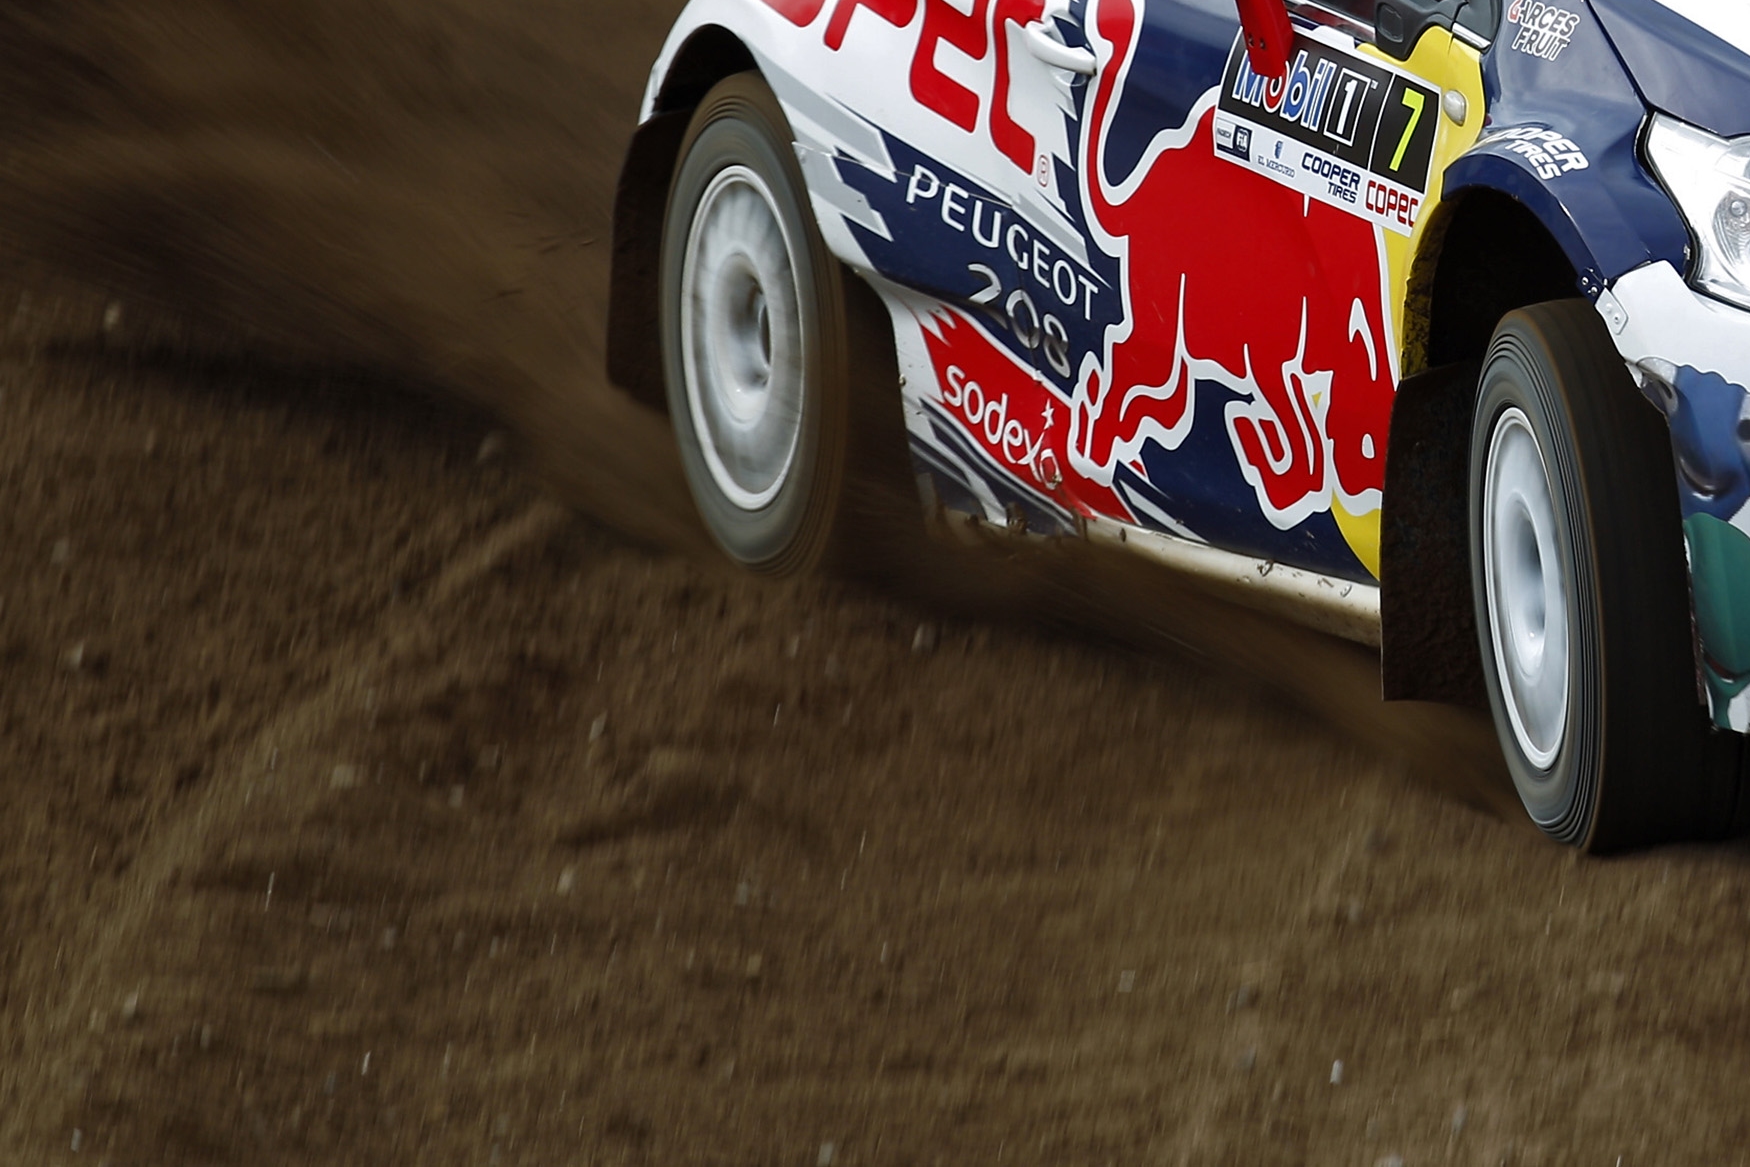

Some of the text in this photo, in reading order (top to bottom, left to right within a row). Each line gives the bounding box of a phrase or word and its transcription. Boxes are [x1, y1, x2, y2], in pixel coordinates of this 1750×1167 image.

[1511, 25, 1571, 64] FRUIT
[1231, 49, 1338, 133] Mobil
[1388, 87, 1426, 172] 7
[1503, 140, 1563, 181] TIRES
[1301, 152, 1361, 191] COOPER
[1327, 181, 1358, 204] TIRES
[906, 164, 1099, 322] PEUGEOT
[967, 263, 1071, 380] 208
